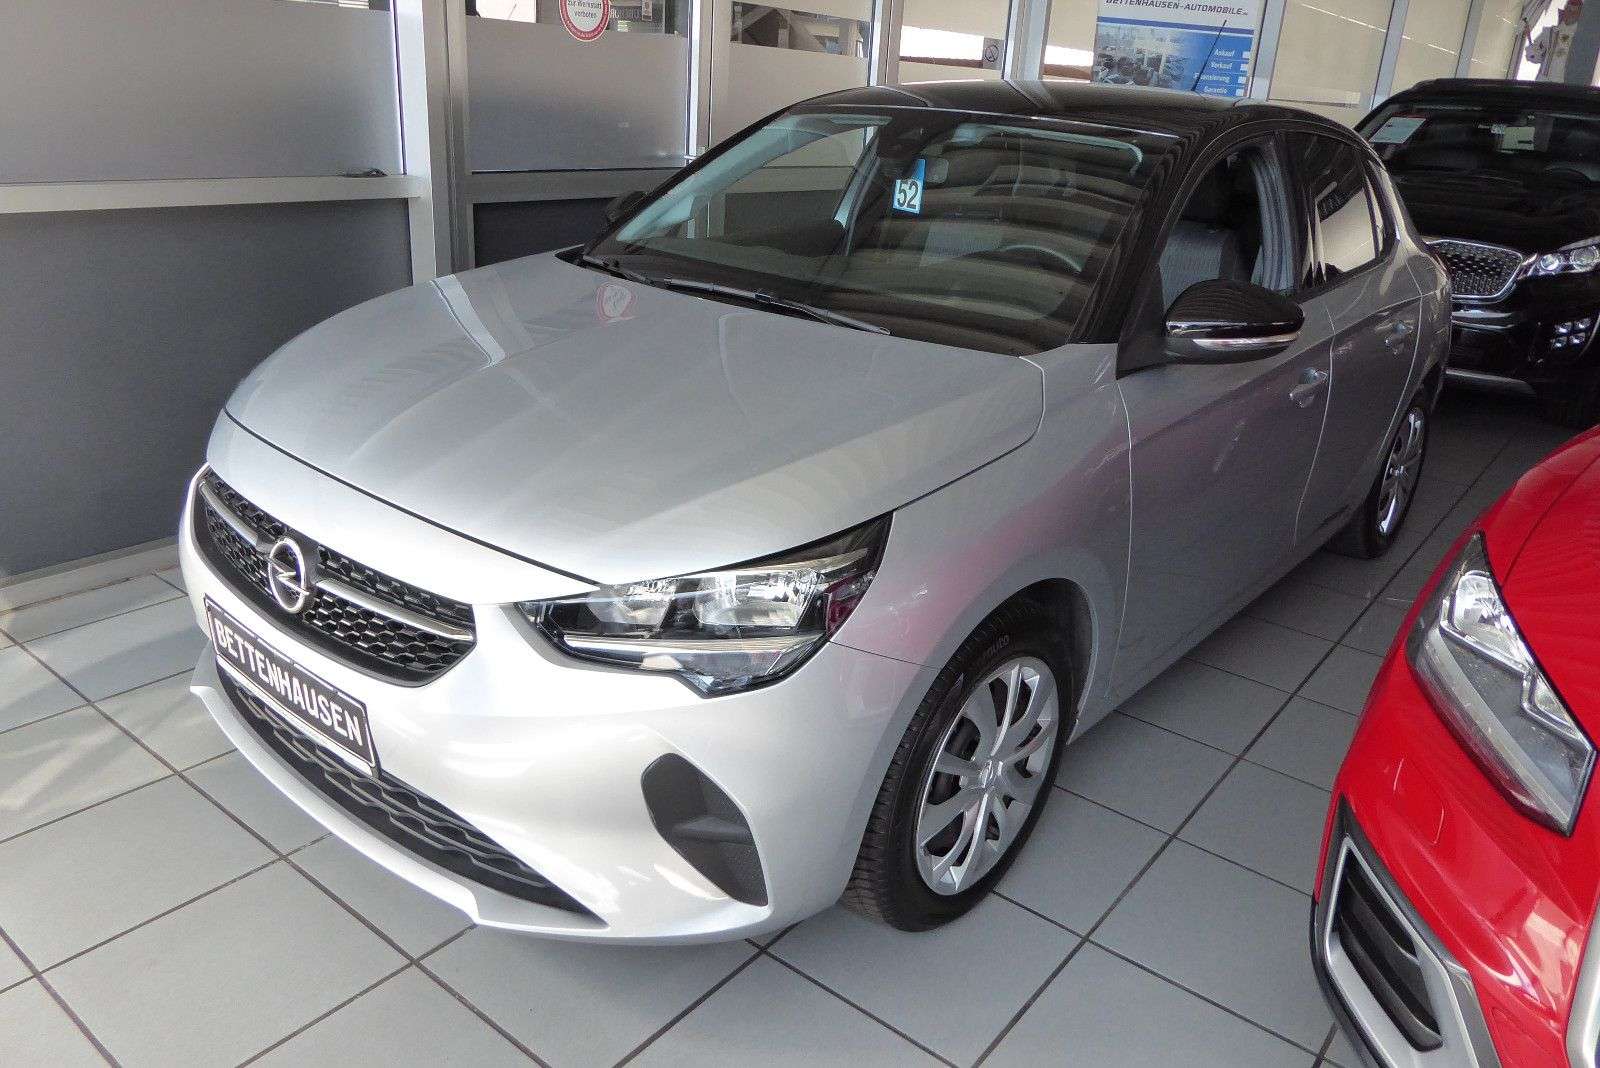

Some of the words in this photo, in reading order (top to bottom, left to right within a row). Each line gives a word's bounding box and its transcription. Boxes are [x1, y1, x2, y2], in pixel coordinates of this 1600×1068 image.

[574, 10, 597, 19] verboten
[1214, 48, 1236, 57] Ankauf
[1210, 61, 1233, 70] Verkauf
[897, 180, 918, 209] 52
[214, 617, 363, 747] BETTENHAUSEN
